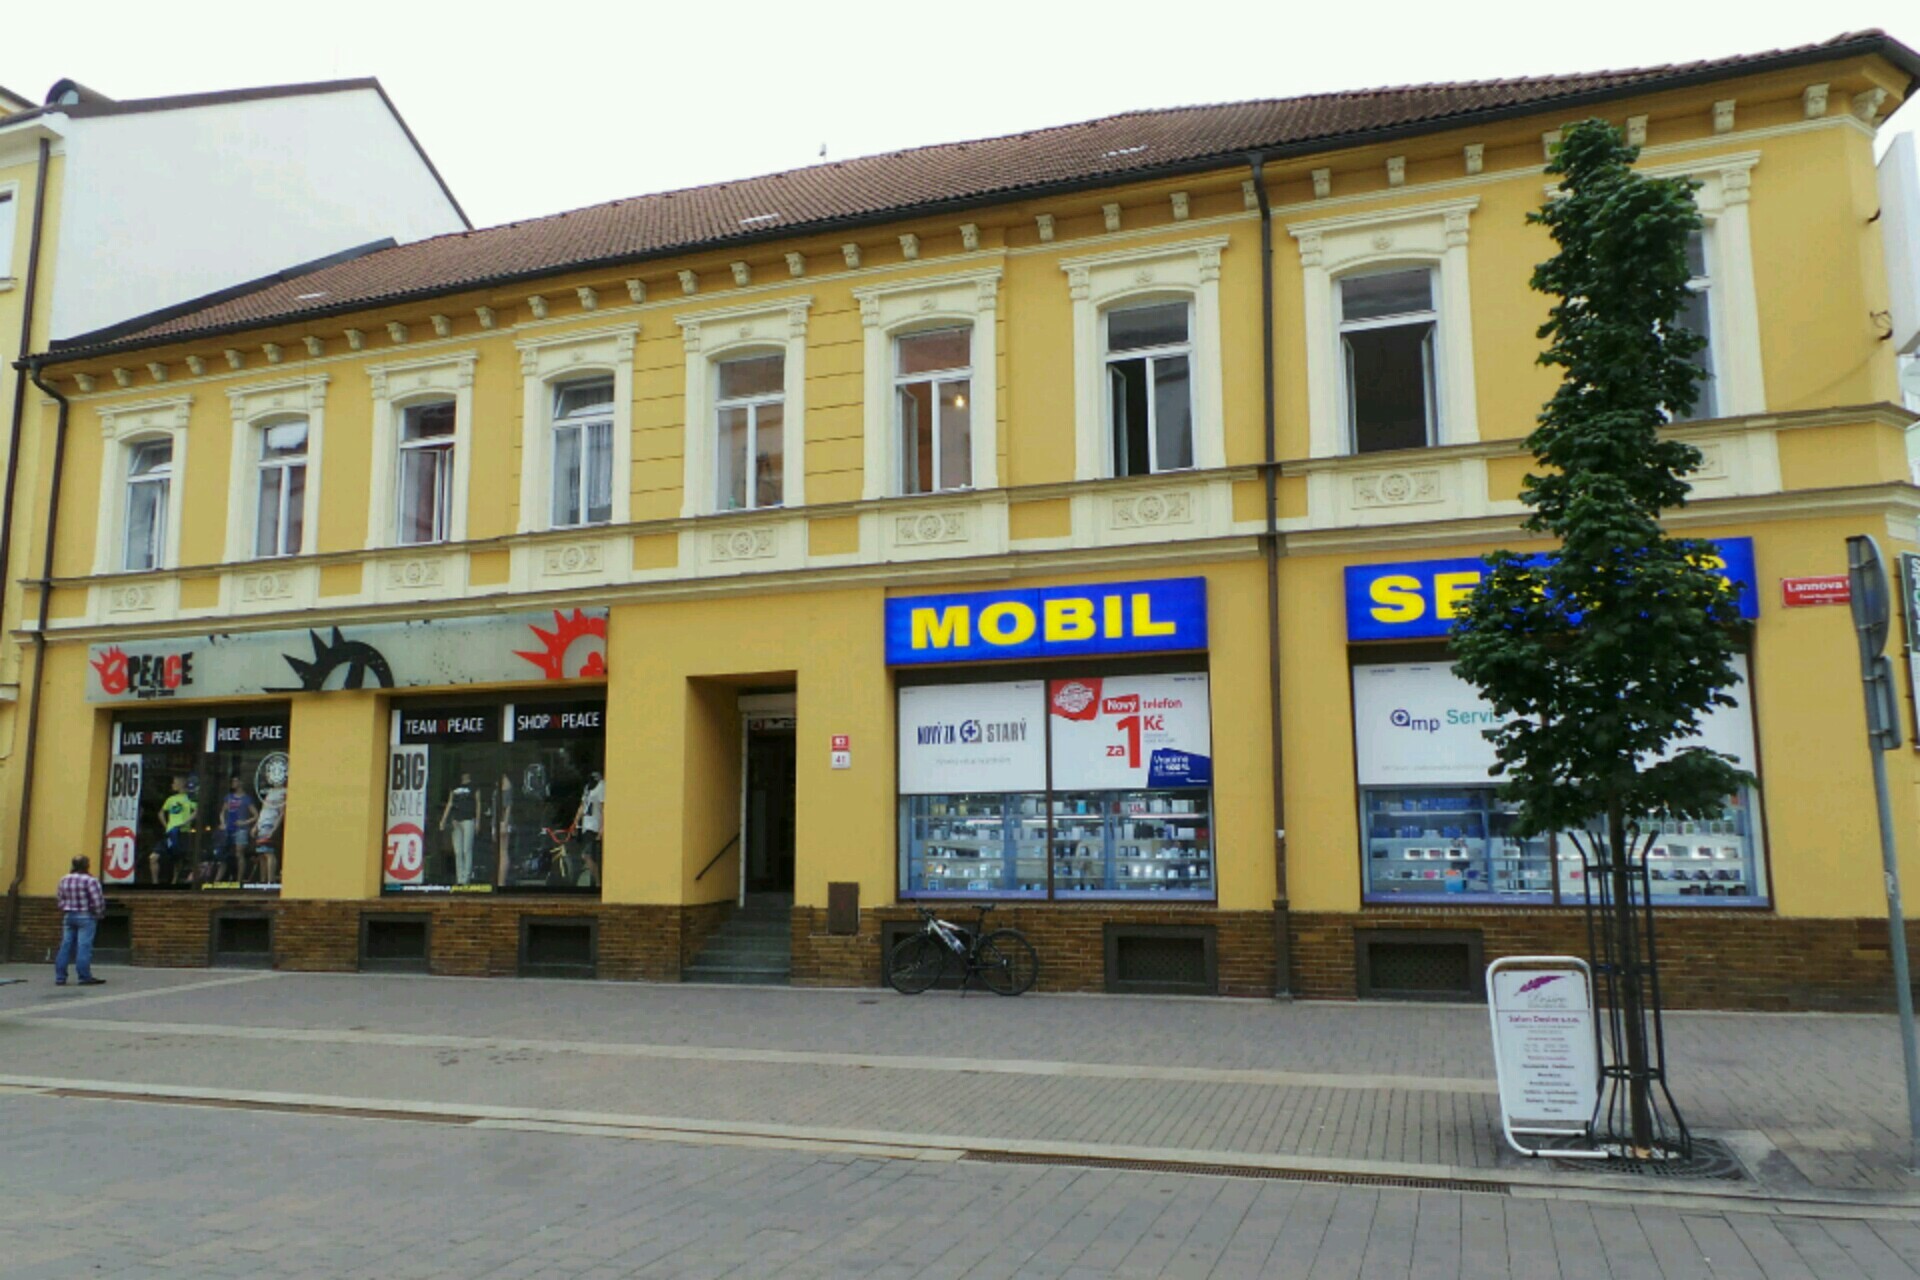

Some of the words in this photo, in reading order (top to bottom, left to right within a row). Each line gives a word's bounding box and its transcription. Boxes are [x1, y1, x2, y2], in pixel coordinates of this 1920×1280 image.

[1786, 581, 1843, 592] Lannova
[911, 593, 1177, 649] MOBIL
[127, 652, 194, 693] PEACE
[1107, 697, 1137, 713] Nový
[1143, 698, 1183, 709] telefon
[217, 727, 241, 741] RIDE
[249, 725, 283, 741] PEACE
[405, 719, 437, 735] TEAM
[447, 717, 484, 733] PEACE
[517, 714, 550, 731] SHOP
[561, 711, 600, 728] PEACE
[917, 721, 942, 745] NOVÝ
[944, 724, 956, 744] ZA
[986, 717, 1027, 743] STARÝ
[123, 731, 144, 745] LIVE
[151, 729, 184, 745] PEACE
[1106, 745, 1125, 757] za
[1116, 715, 1141, 768] 1
[1143, 714, 1165, 731] Kč
[111, 762, 139, 798] BIG
[391, 752, 425, 791] BIG
[109, 798, 137, 821] SALE
[389, 791, 423, 817] SALE
